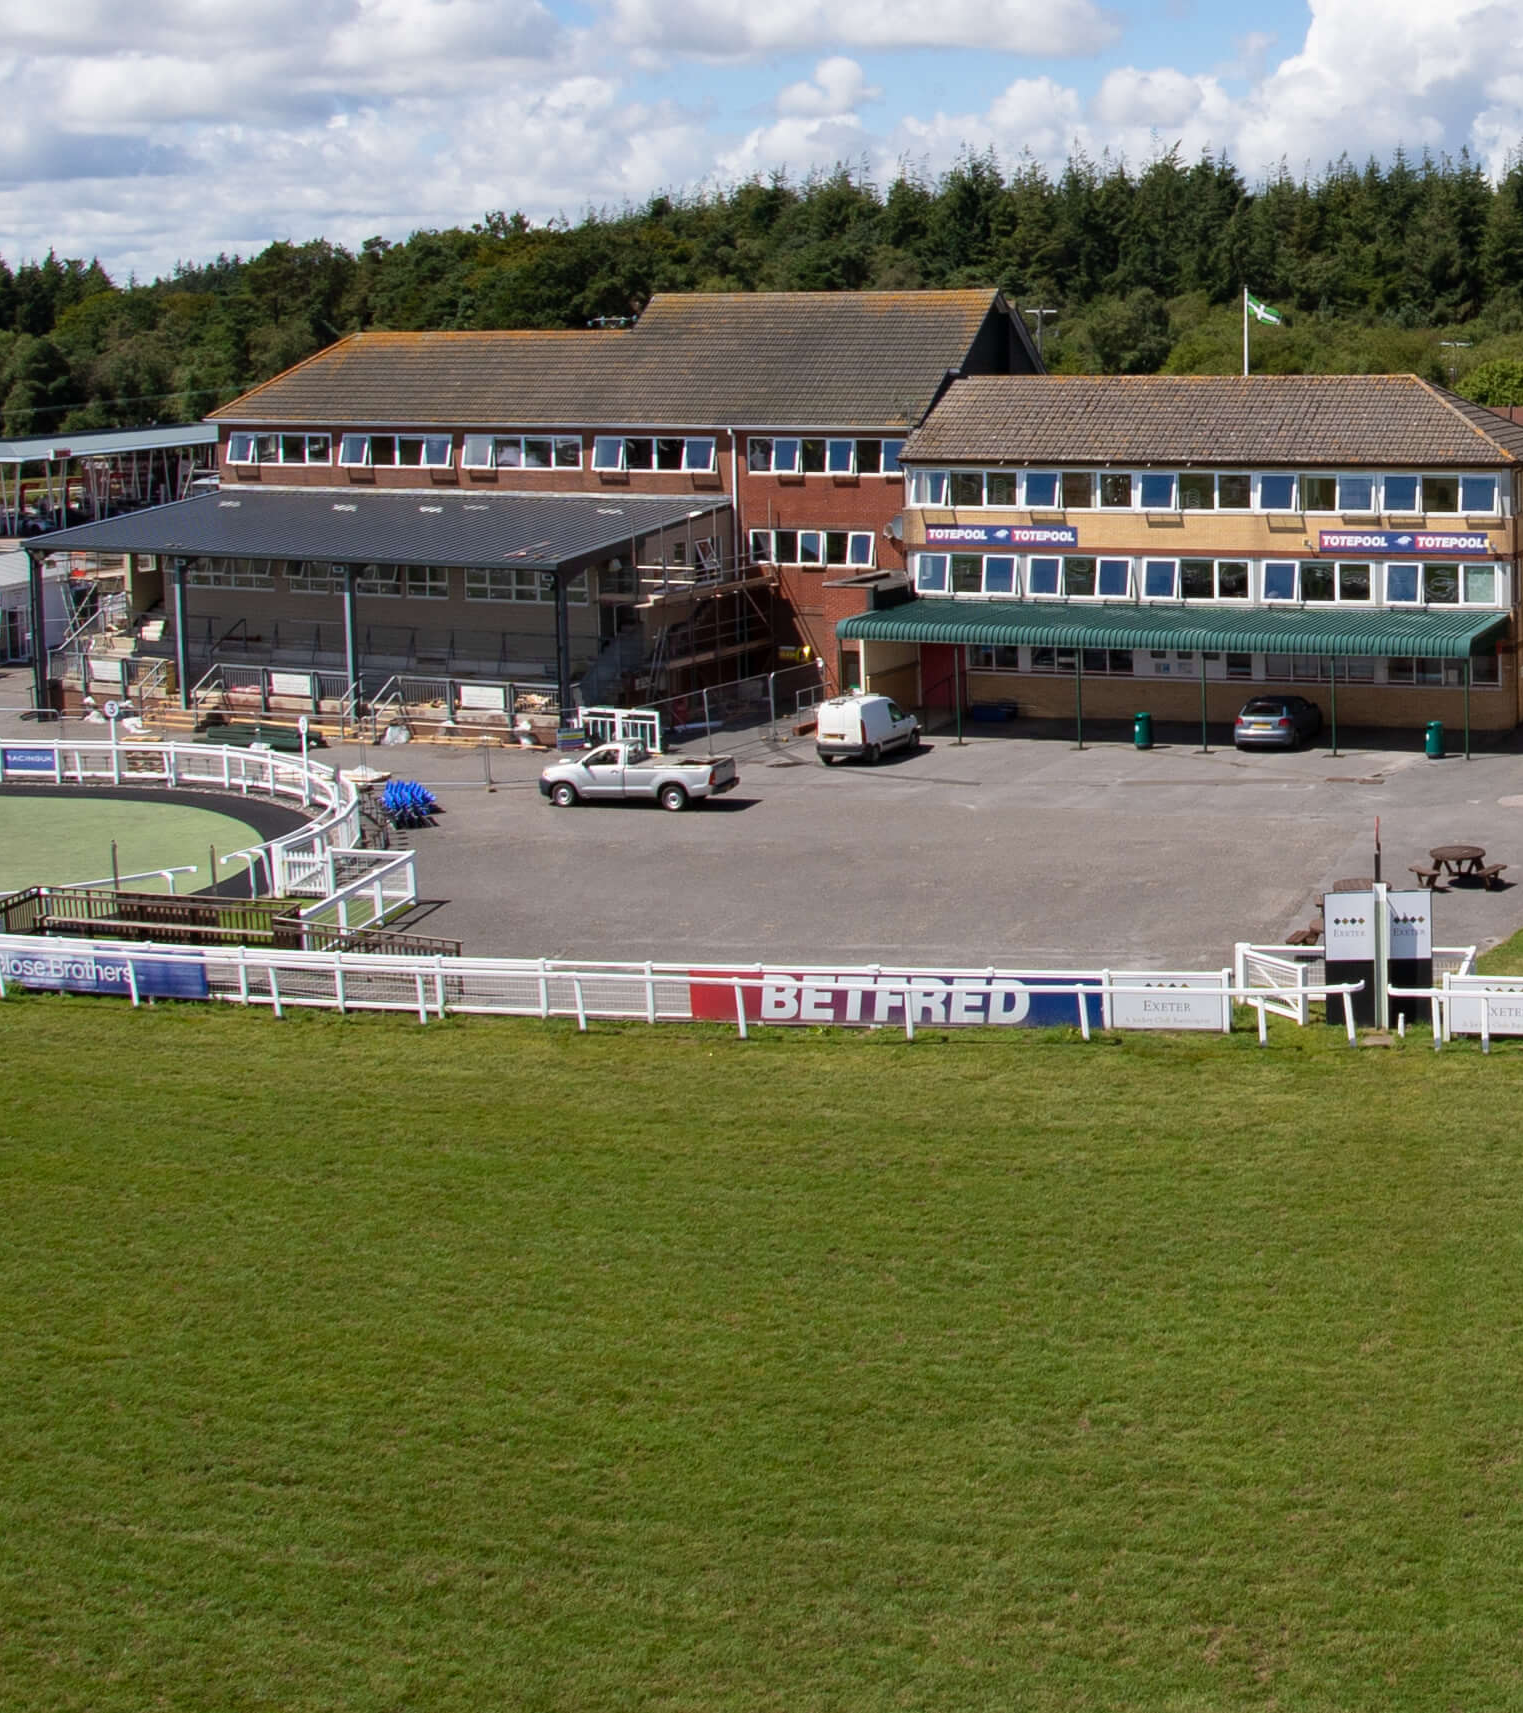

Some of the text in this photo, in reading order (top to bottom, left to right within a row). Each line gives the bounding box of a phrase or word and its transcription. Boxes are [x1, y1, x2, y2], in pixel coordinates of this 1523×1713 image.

[929, 528, 1074, 542] TOTEPOOL TOTEPOOL
[1322, 535, 1484, 548] TOTEPOOL TOTEPOOL
[108, 703, 116, 714] 3
[760, 973, 1031, 1025] BETFRED
[1143, 999, 1191, 1012] EXETER
